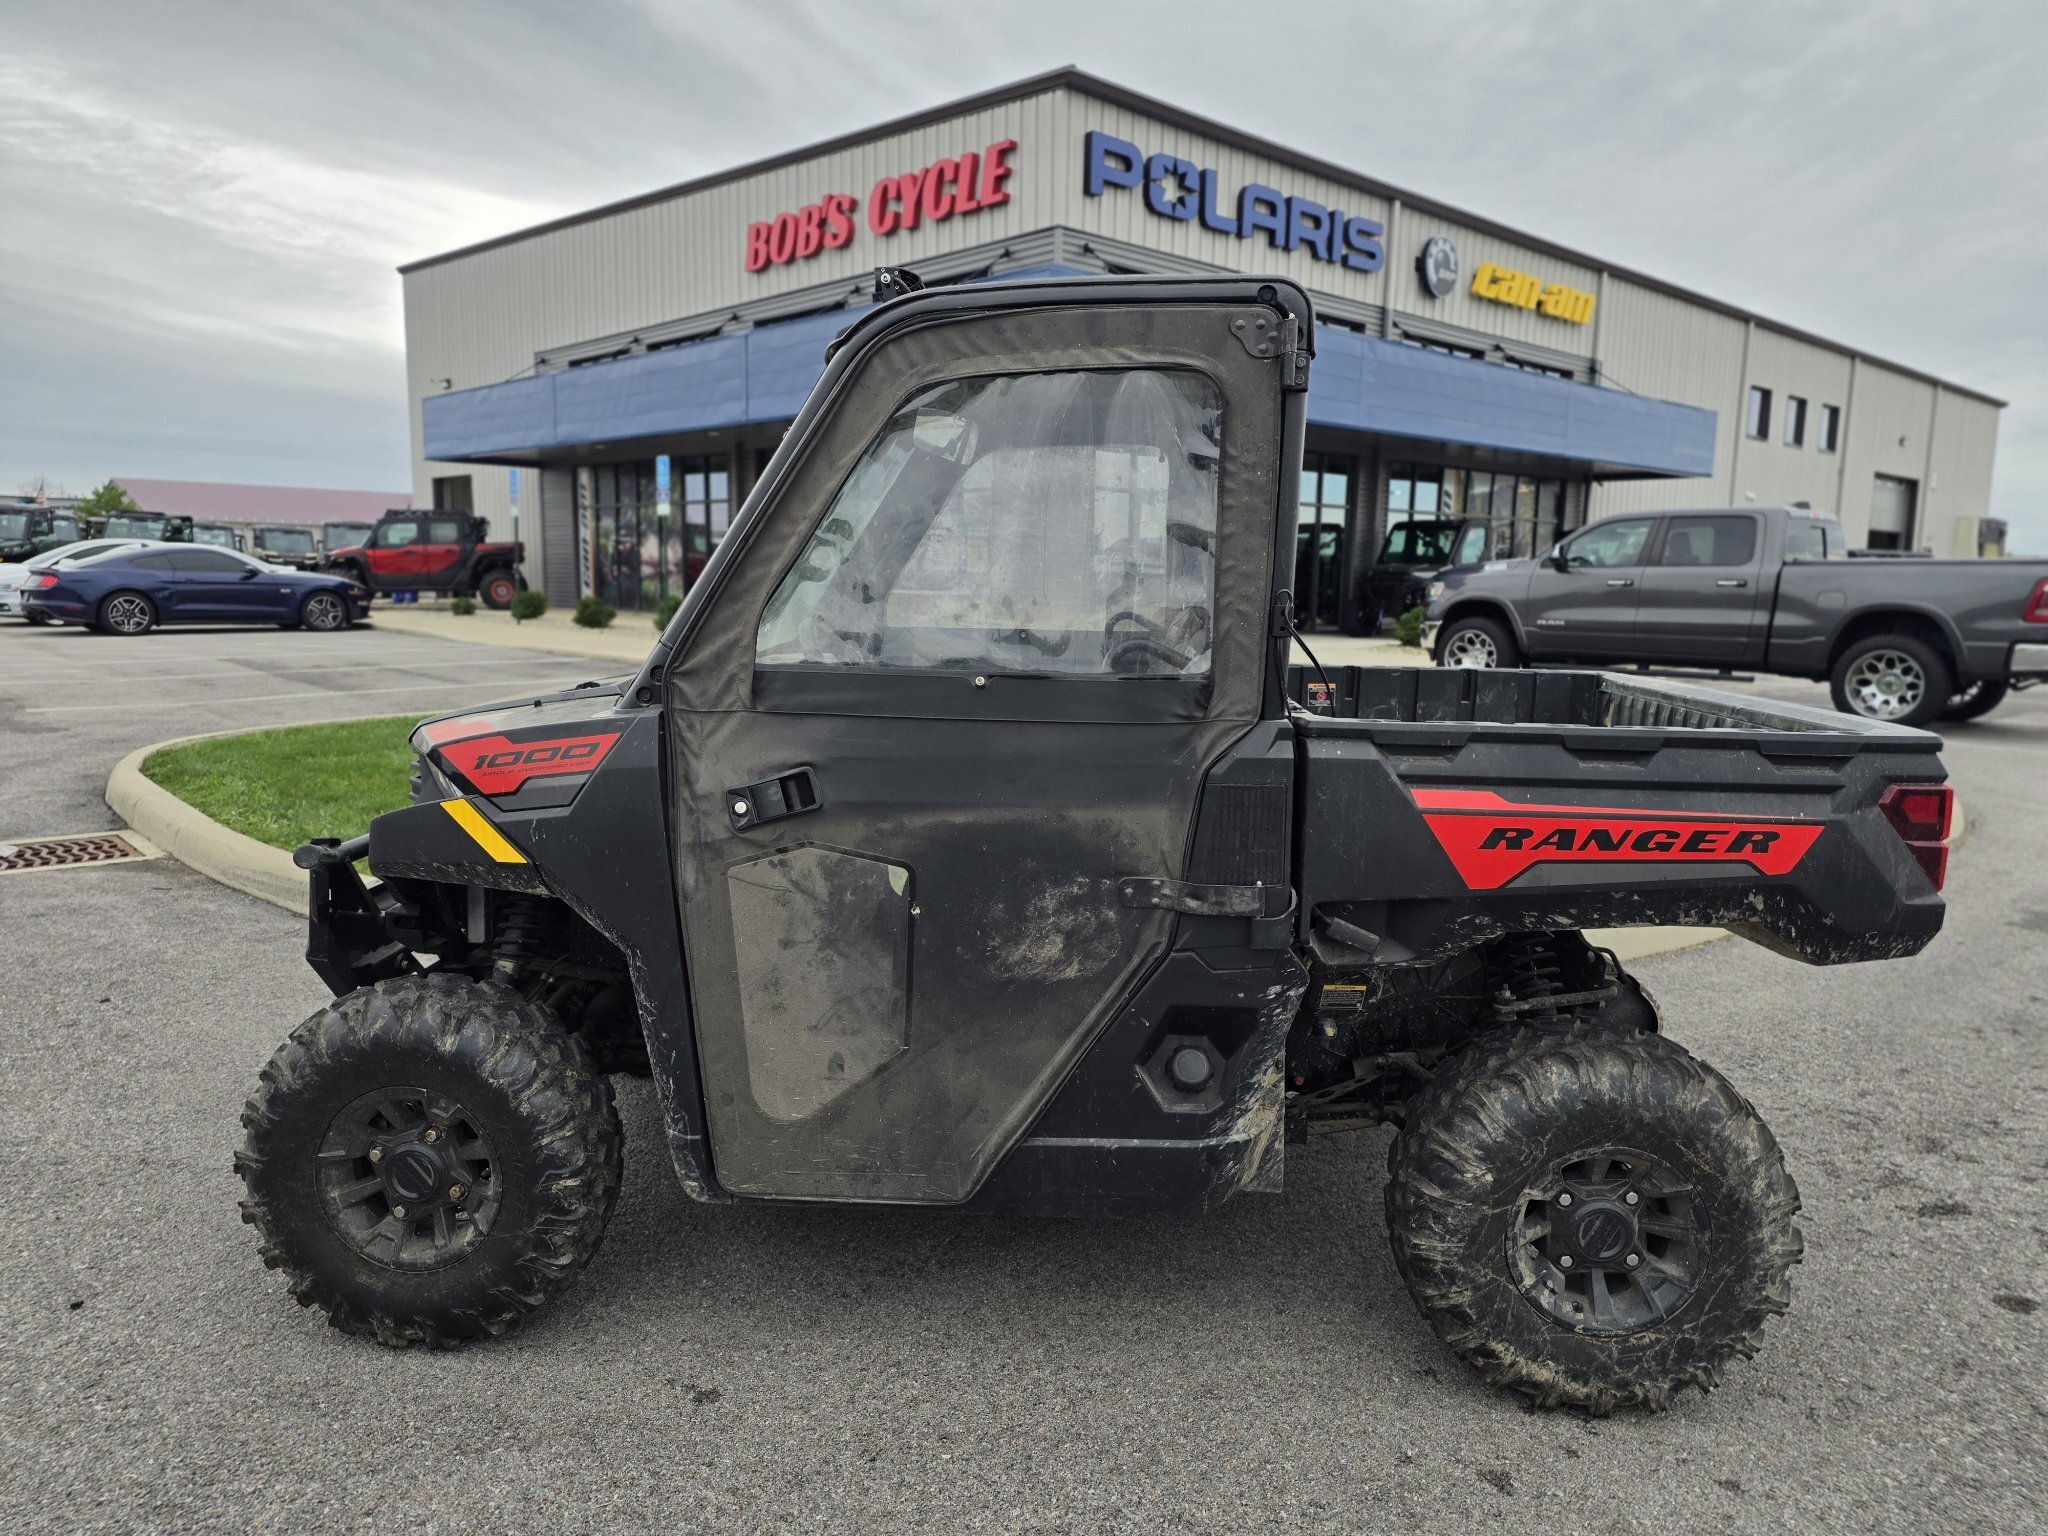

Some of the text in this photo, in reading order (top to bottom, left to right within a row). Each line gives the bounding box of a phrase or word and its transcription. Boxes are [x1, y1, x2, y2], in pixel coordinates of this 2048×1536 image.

[745, 139, 1018, 272] BOB'S CYCLE
[1084, 130, 1385, 273] POLARIS
[474, 742, 600, 770] 1000
[481, 769, 515, 777] SINGLE
[518, 762, 567, 773] OVERHEAD
[1478, 827, 1781, 854] RANGER
